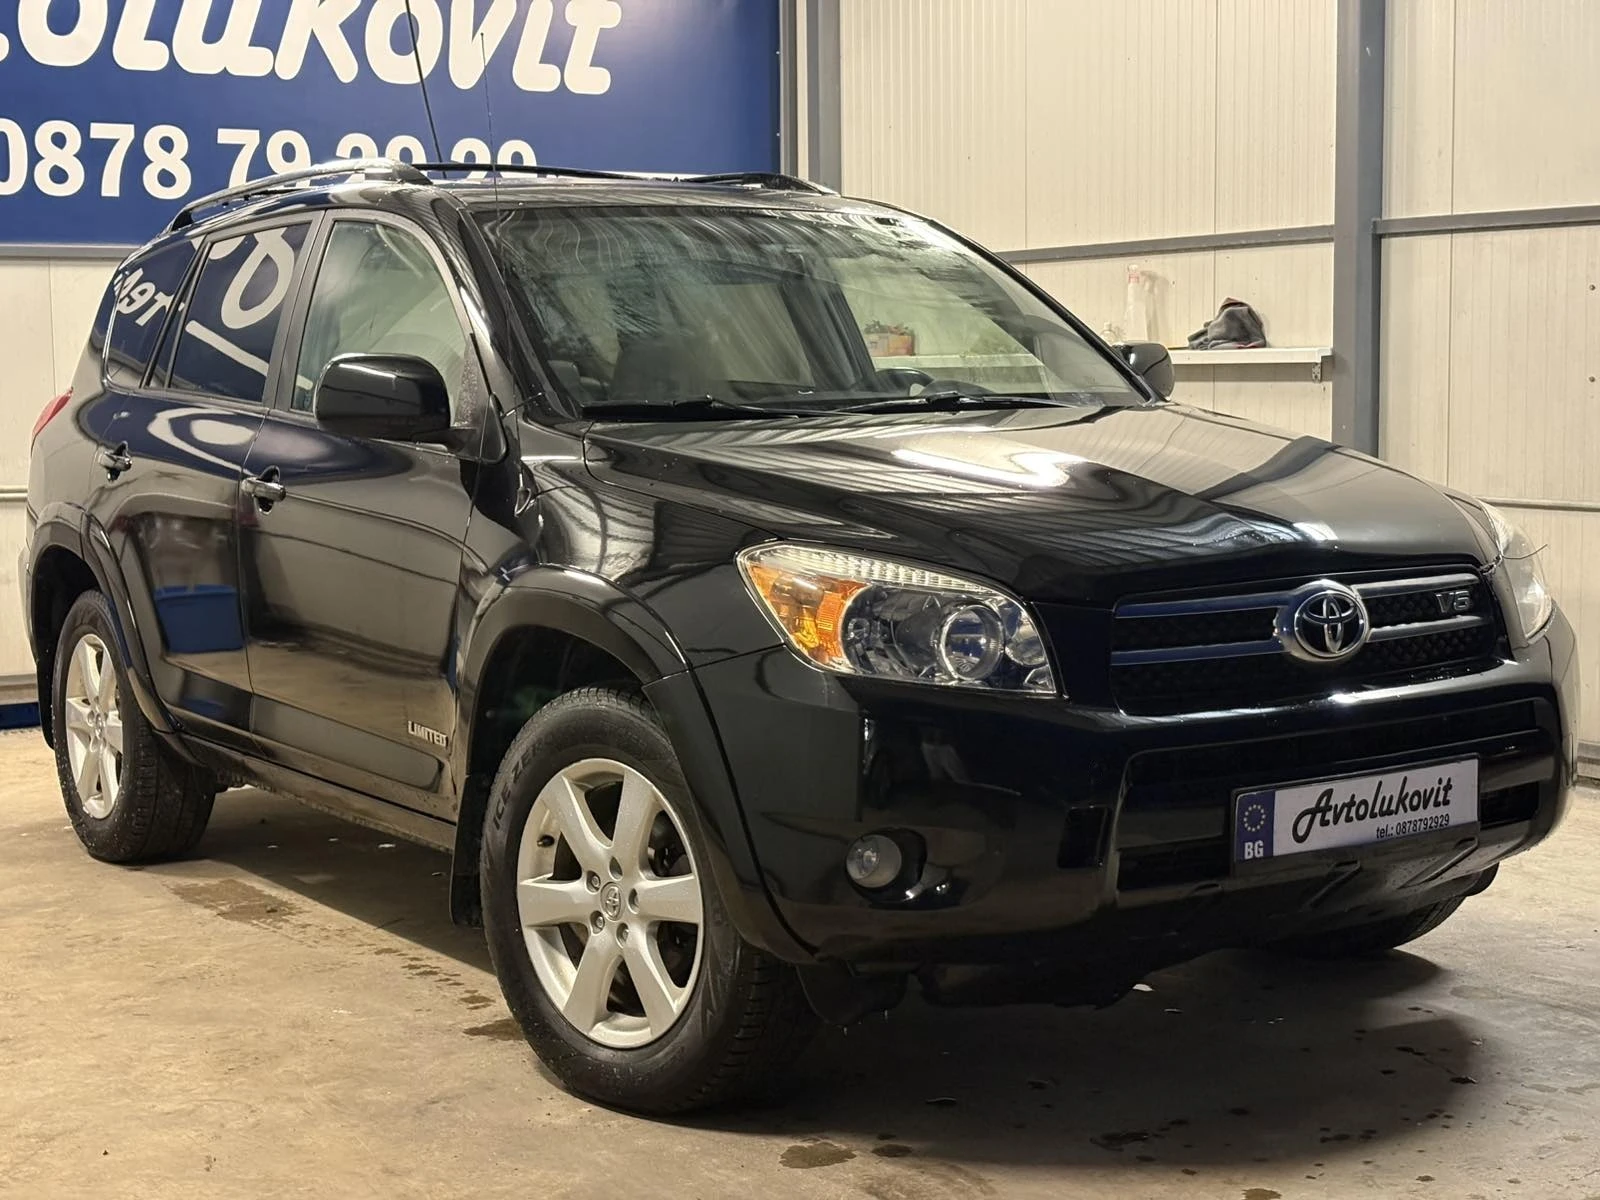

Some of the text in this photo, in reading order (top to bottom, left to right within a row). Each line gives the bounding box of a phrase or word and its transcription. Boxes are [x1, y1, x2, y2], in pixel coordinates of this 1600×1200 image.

[0, 118, 192, 200] 0878
[1435, 590, 1469, 613] V6
[408, 720, 448, 748] LIMITED
[1292, 776, 1453, 843] Avtolukovit
[1396, 813, 1450, 835] 0878792929
[1244, 840, 1264, 860] BG
